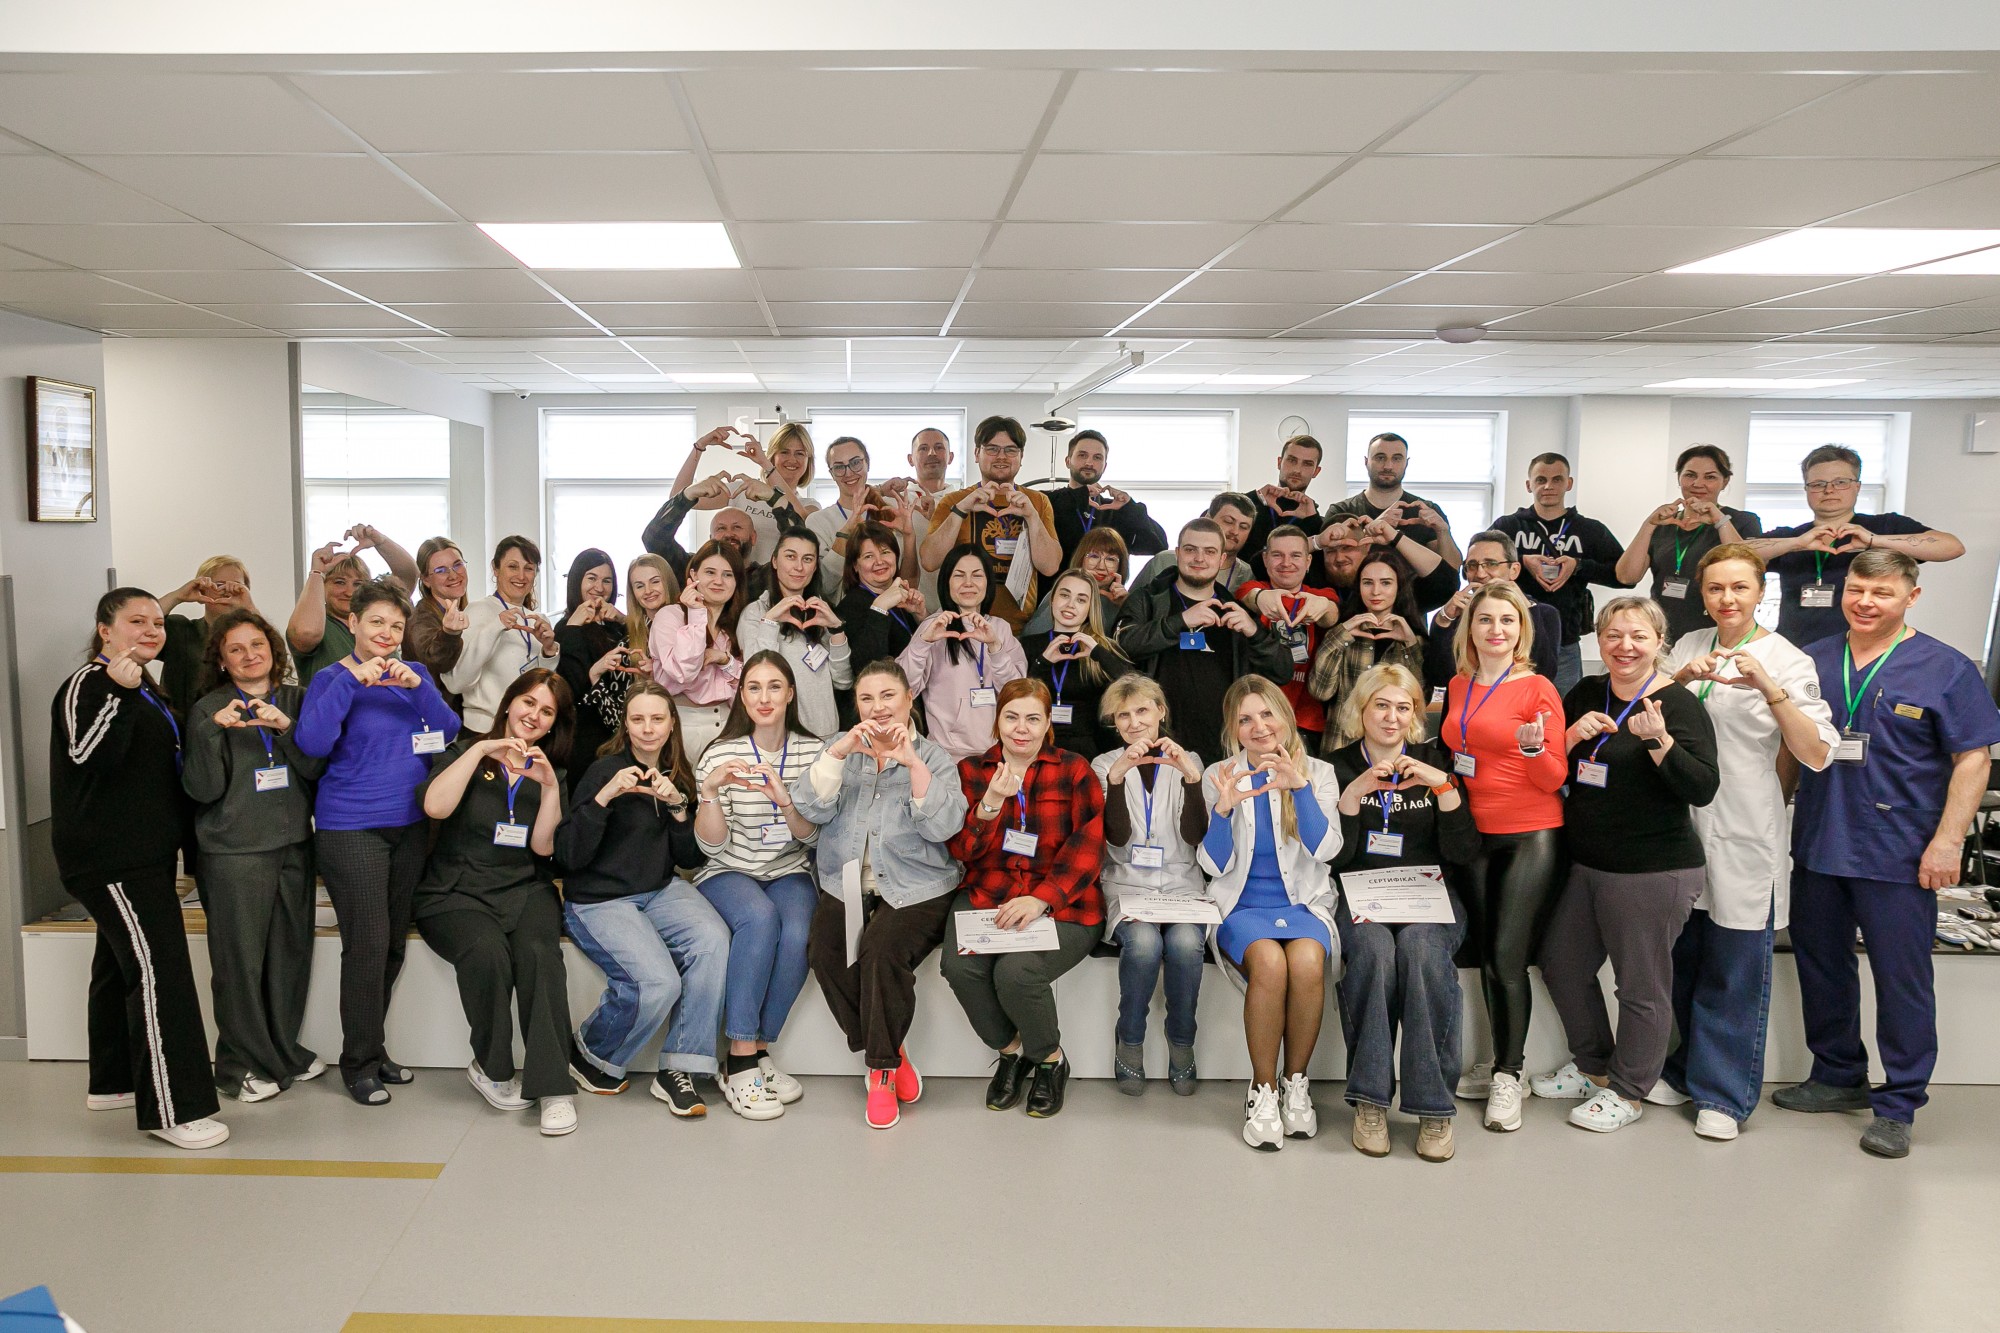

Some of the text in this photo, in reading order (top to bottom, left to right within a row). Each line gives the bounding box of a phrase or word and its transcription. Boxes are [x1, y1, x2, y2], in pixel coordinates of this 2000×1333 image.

[745, 505, 776, 520] РЕАБ
[1360, 796, 1432, 813] BALNCIAGA
[1369, 876, 1417, 884] СЕРТИФІКАТ
